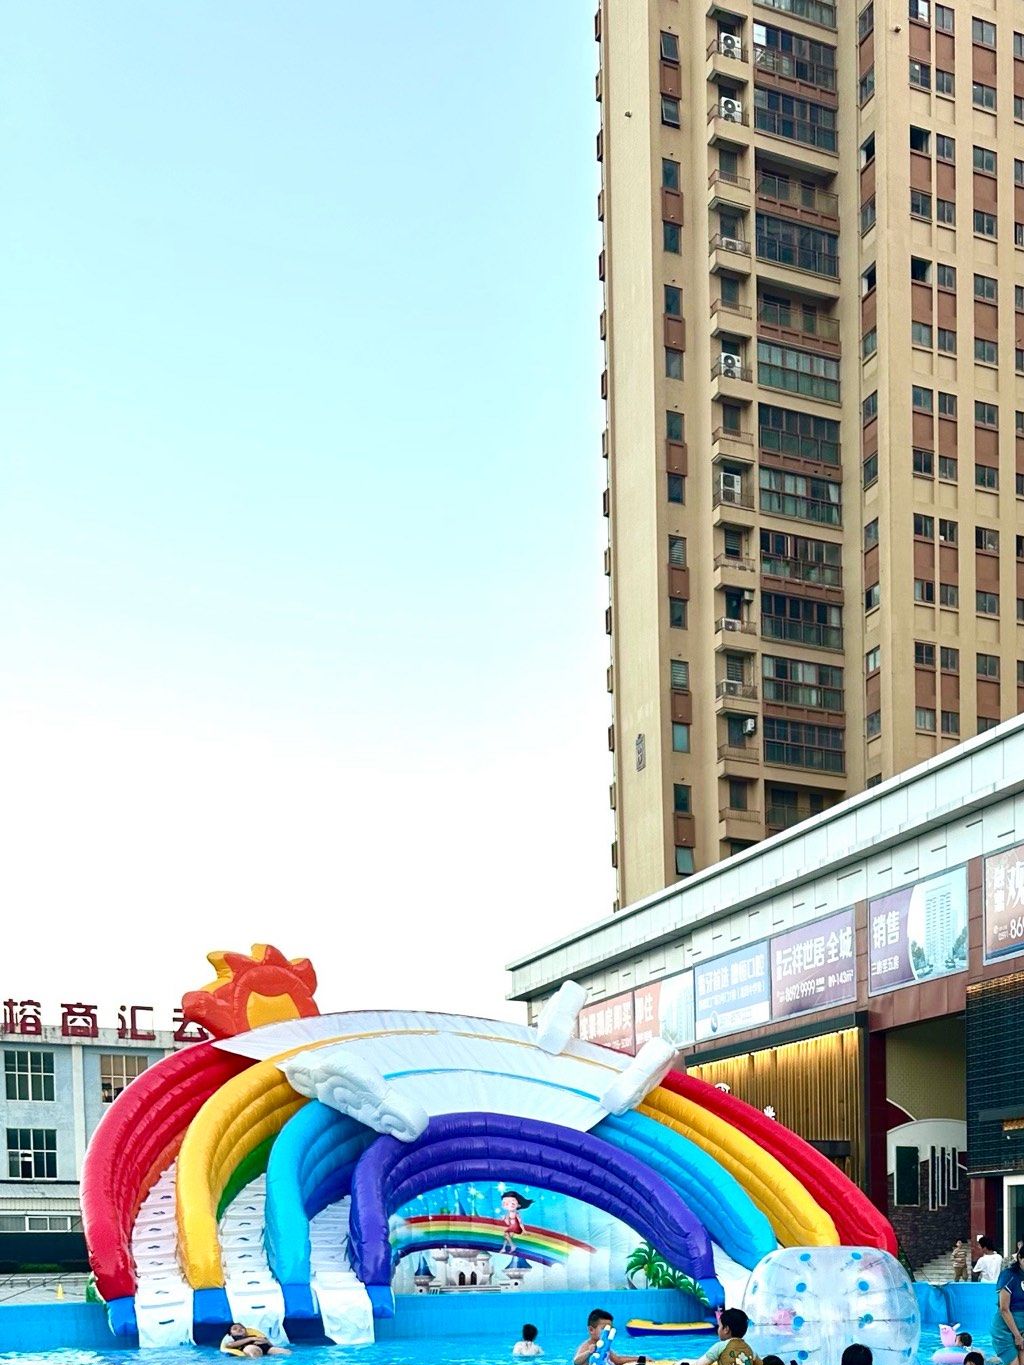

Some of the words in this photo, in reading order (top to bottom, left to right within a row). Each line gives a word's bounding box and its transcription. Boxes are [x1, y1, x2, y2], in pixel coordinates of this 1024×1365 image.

[782, 935, 825, 976] 云祥世居
[827, 927, 853, 963] 全城
[872, 910, 900, 949] 销售
